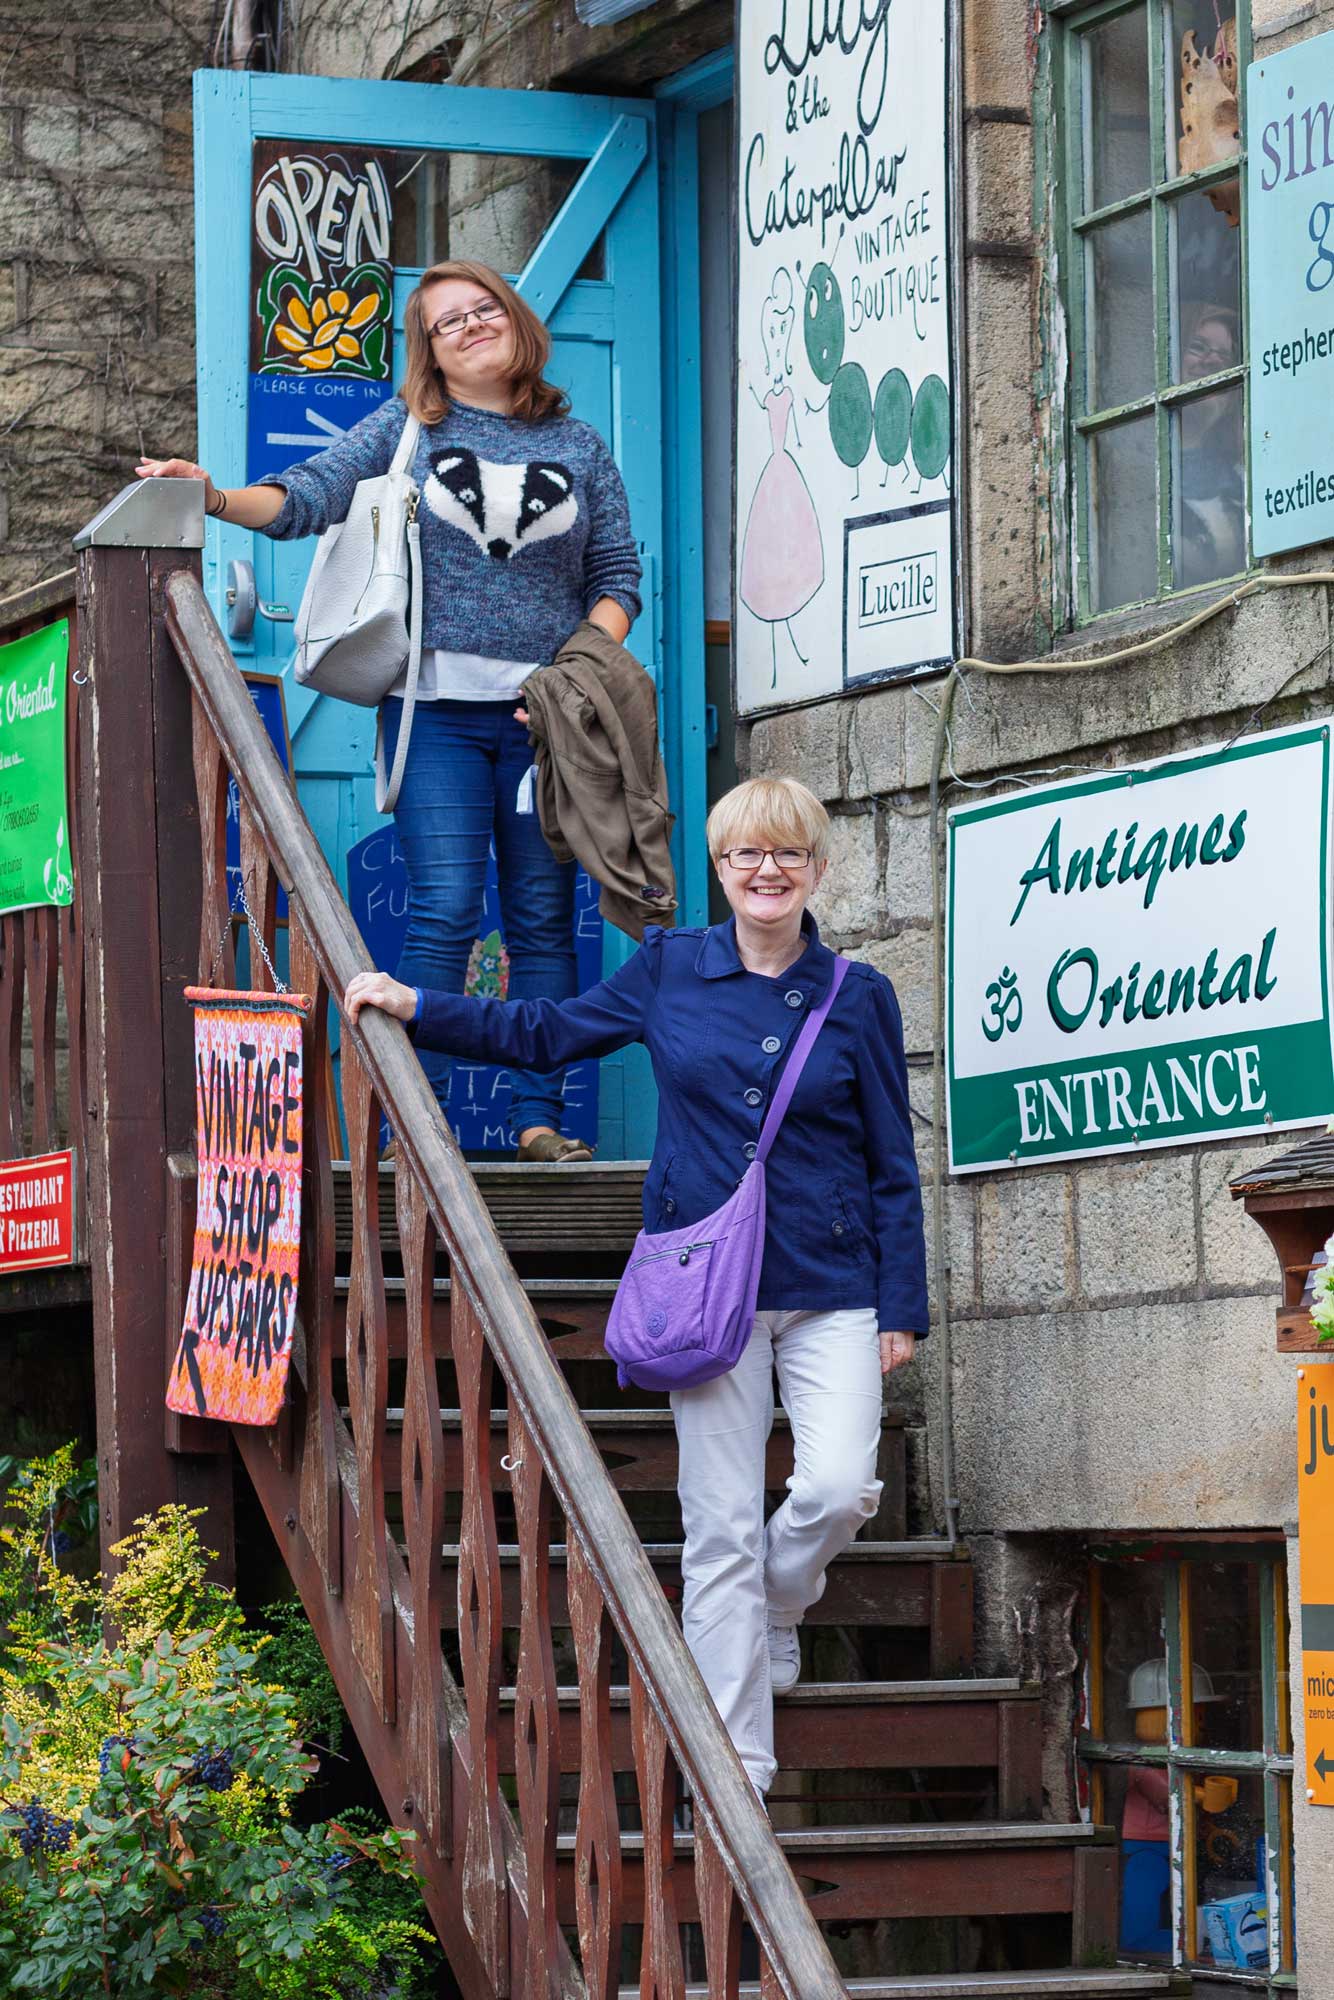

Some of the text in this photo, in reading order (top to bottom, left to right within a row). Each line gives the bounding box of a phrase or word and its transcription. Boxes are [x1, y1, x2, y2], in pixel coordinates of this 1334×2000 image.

[786, 75, 830, 134] & the
[255, 157, 390, 281] OPEN
[746, 132, 907, 247] Caterpillar
[855, 191, 931, 264] VINTAGE
[849, 256, 940, 340] BOUTIQUE
[254, 378, 381, 398] PLEASE COME IN
[861, 563, 934, 617] Lucille
[6, 661, 56, 724] Oriental
[1010, 808, 1248, 926] Antiques
[1047, 927, 1278, 1034] Oriental
[198, 1042, 300, 1160] VINTAGE
[1013, 1044, 1268, 1144] ENTRANCE
[8, 1217, 60, 1252] PIZZERIA
[211, 1165, 281, 1266] SHOP
[198, 1257, 292, 1377] UPSTAIRS
[1309, 1709, 1325, 1719] zero
